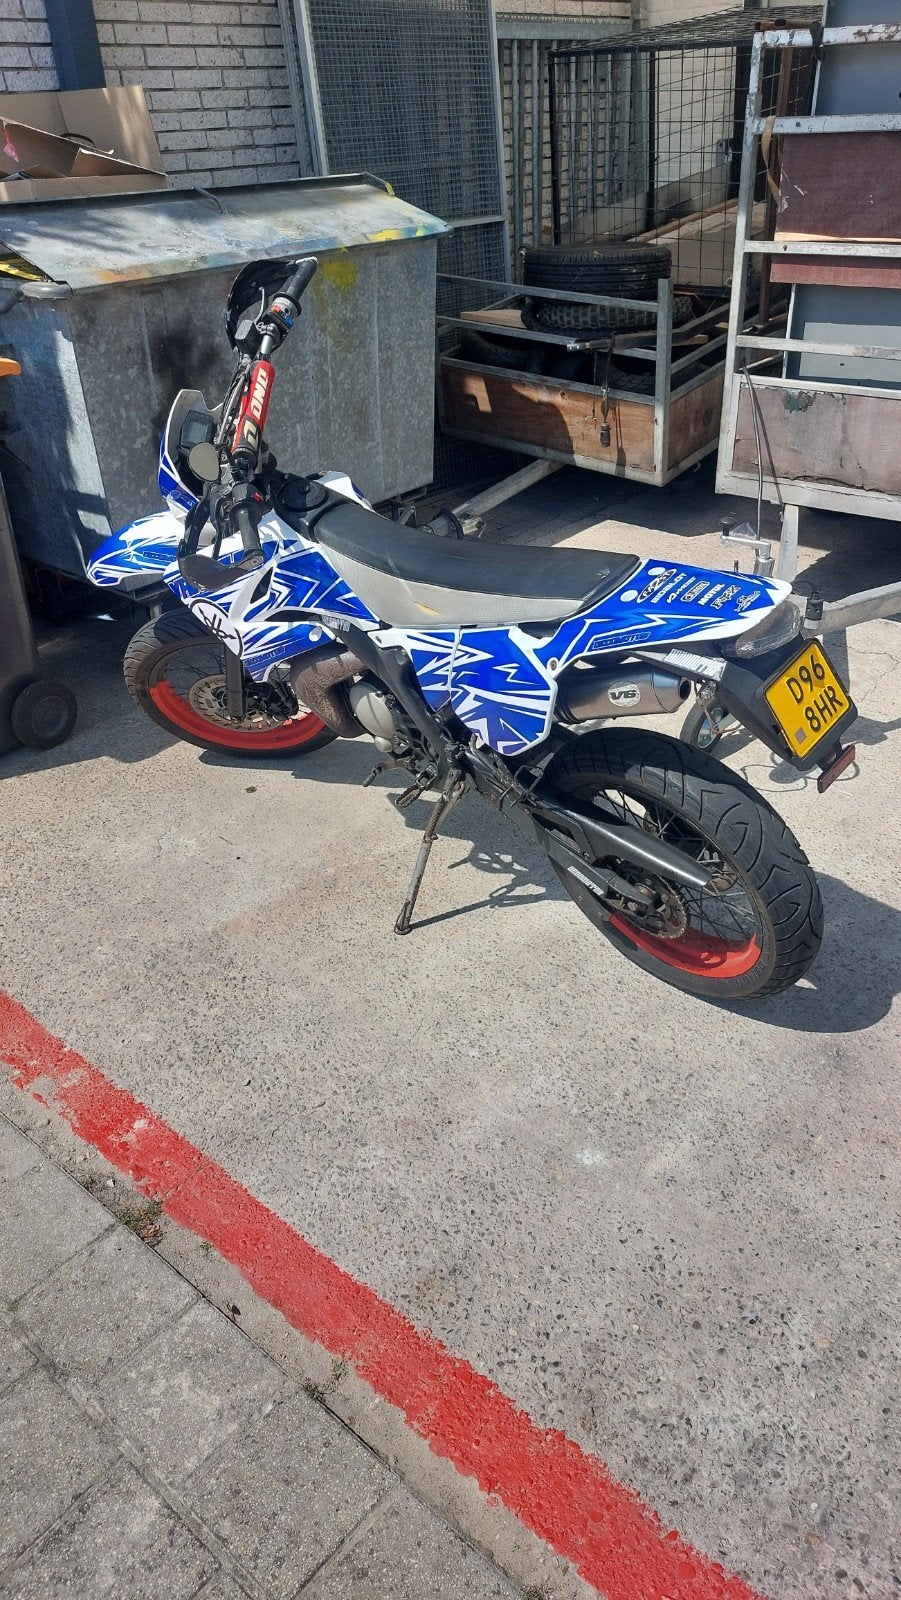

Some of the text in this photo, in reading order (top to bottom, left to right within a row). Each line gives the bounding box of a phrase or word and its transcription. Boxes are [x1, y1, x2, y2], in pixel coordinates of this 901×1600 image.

[610, 689, 637, 701] V6
[786, 654, 825, 704] D96
[804, 685, 844, 732] 8HR
